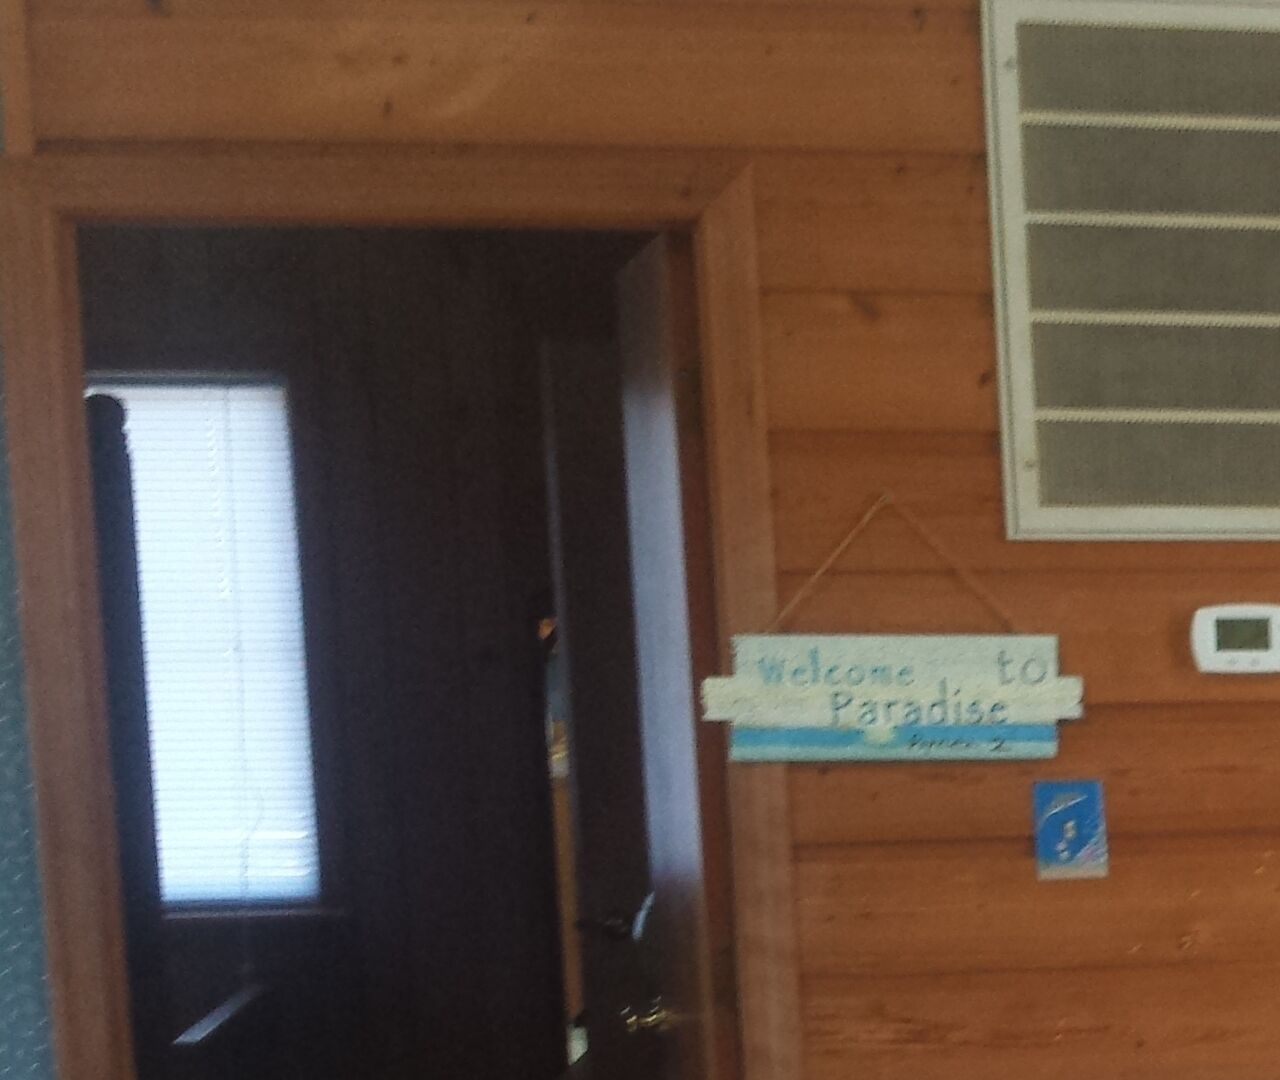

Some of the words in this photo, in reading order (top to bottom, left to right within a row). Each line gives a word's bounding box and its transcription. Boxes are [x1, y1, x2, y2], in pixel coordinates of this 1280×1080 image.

[757, 645, 915, 687] Welcome
[996, 649, 1048, 686] to
[830, 677, 1010, 727] Paradise
